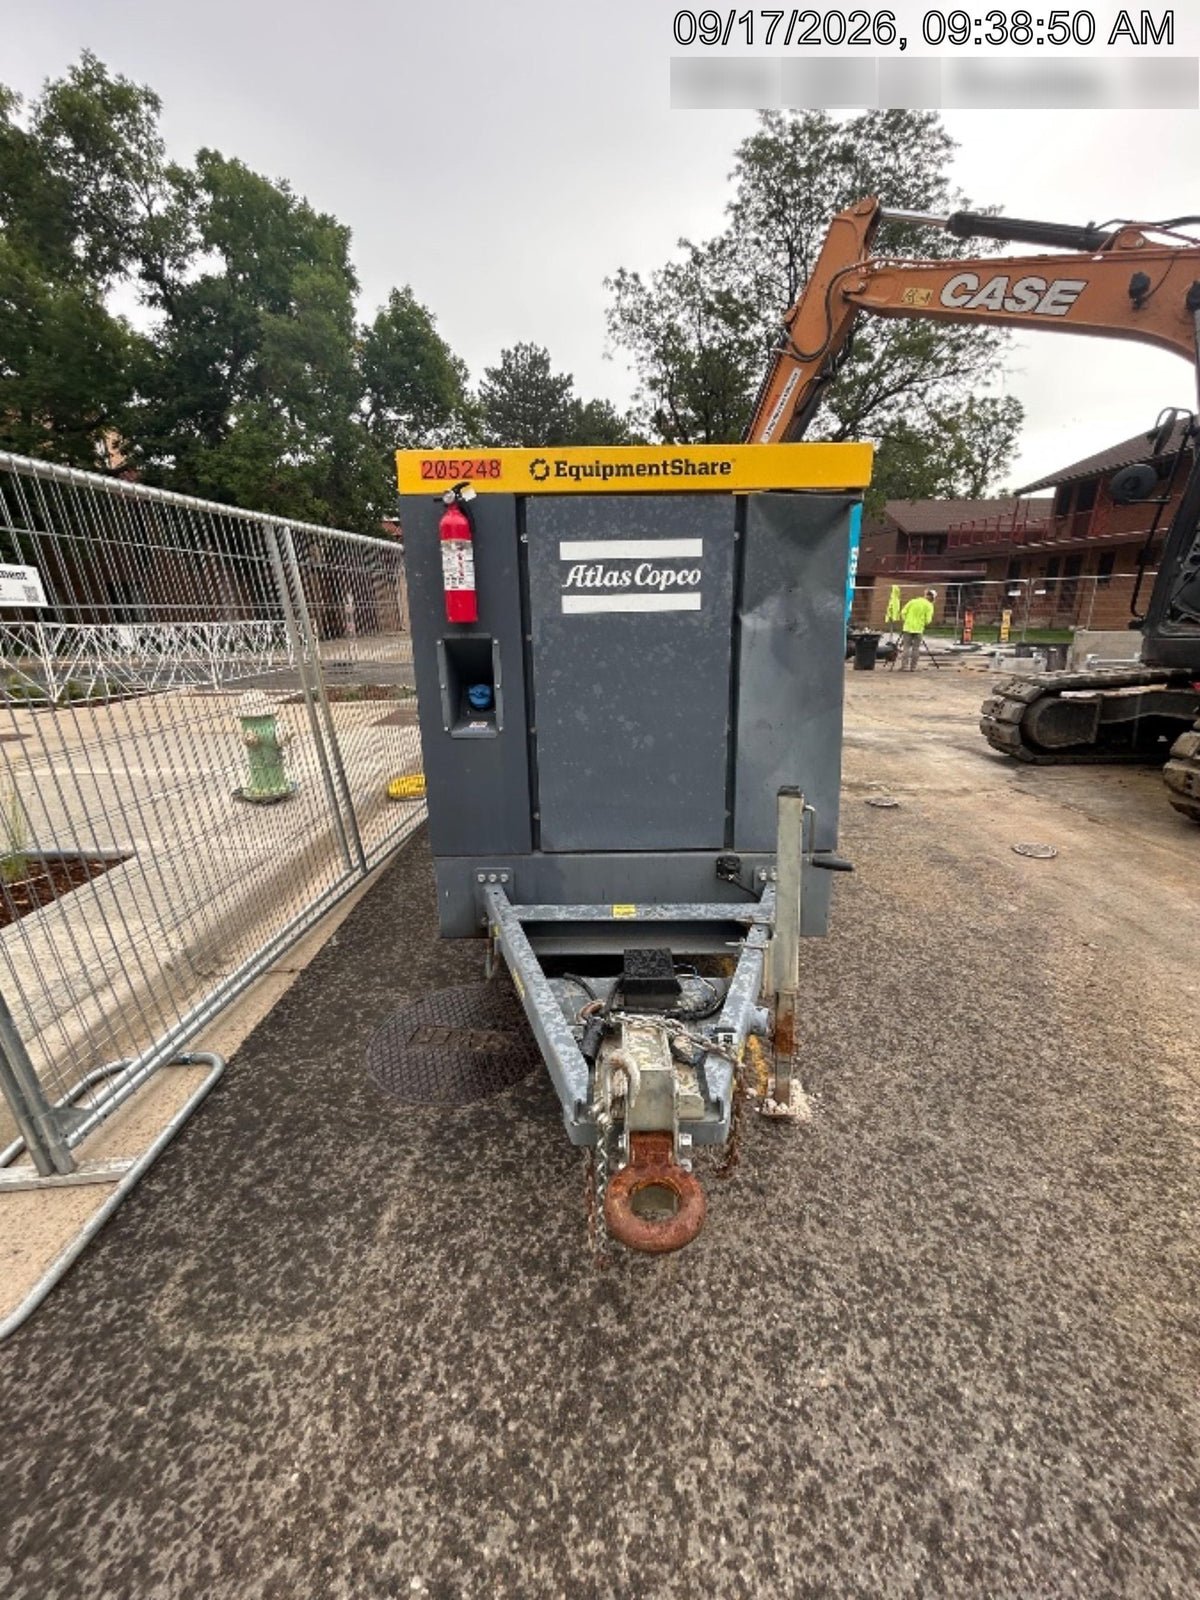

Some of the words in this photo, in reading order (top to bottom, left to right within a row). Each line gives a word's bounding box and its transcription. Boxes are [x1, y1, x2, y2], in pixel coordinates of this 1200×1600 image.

[939, 272, 1089, 317] CASE
[422, 460, 500, 479] 205248
[554, 458, 732, 481] EquipmentShare
[561, 564, 632, 588] Atlas
[634, 563, 702, 591] Copco
